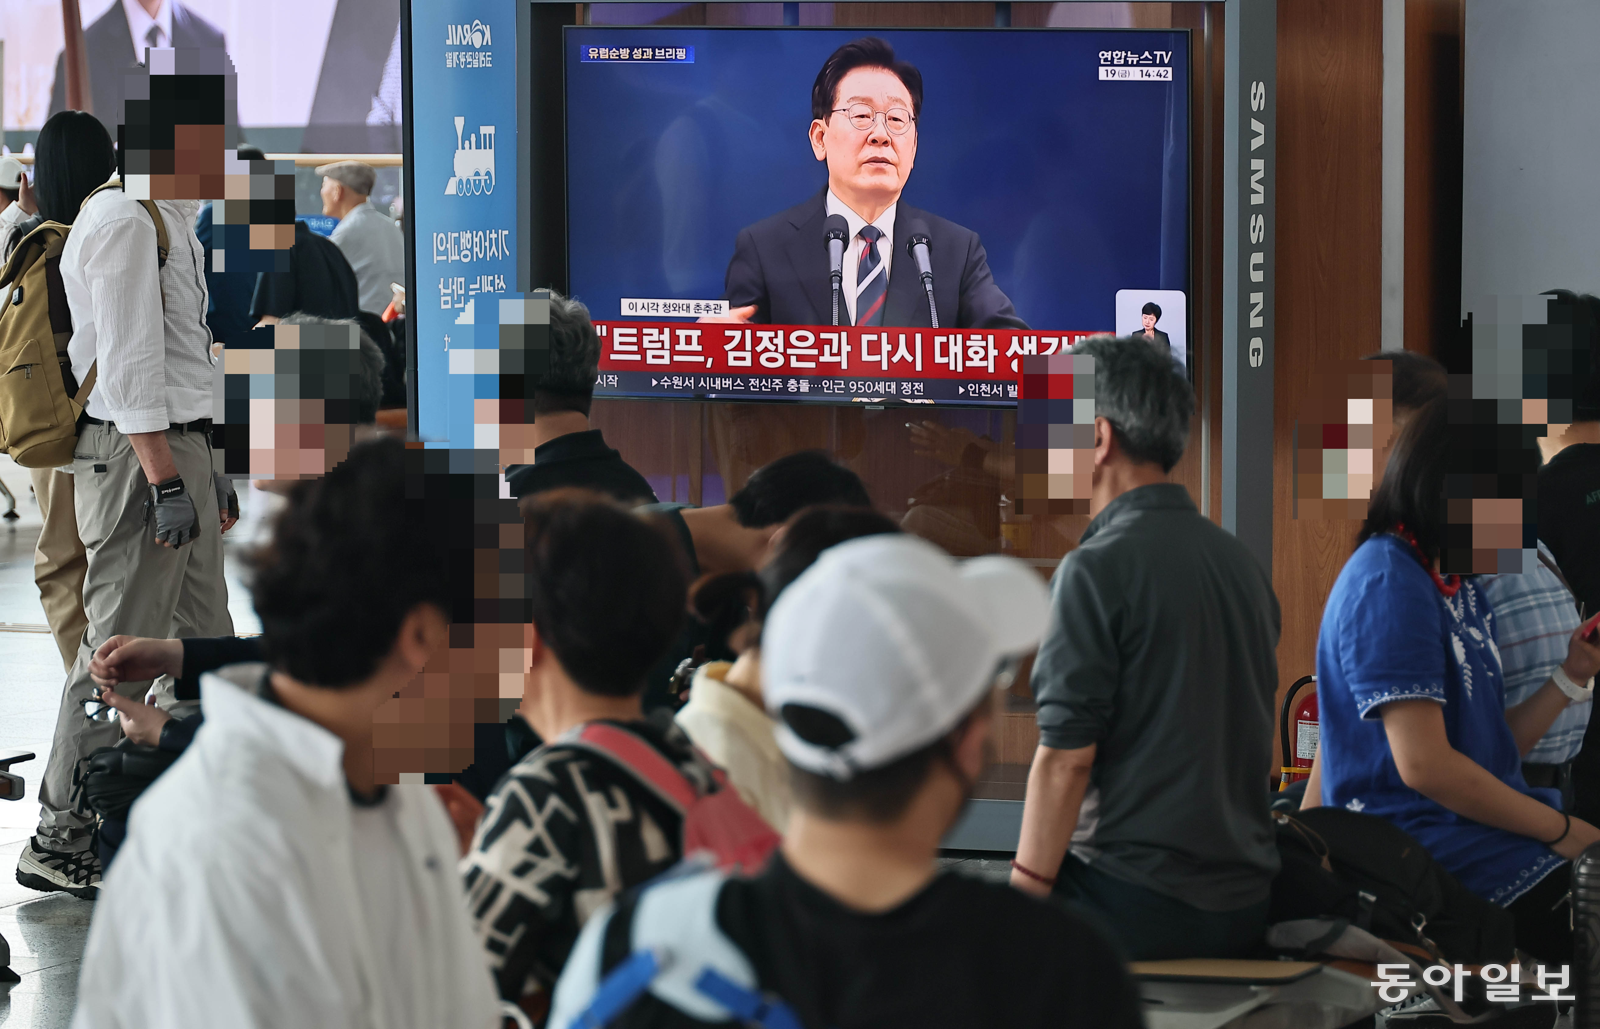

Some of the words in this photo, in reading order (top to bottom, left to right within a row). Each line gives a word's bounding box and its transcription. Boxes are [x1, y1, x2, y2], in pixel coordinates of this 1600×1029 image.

[588, 47, 630, 60] 유럽순방
[632, 48, 653, 60] 성과
[654, 48, 687, 60] 브리핑
[1098, 50, 1172, 65] 연합뉴스TV
[1139, 69, 1169, 79] 14:42
[1249, 80, 1266, 368] SAMSUNG
[628, 302, 638, 313] 이
[640, 302, 659, 314] 시각
[662, 302, 691, 314] 청와대
[693, 303, 723, 315] 춘추관
[723, 329, 852, 370] 김정은과
[861, 332, 923, 372] 다시
[934, 333, 999, 374] 대화
[659, 375, 695, 390] 수원서
[698, 376, 745, 391] 시내버스
[748, 378, 783, 392] 전신주
[848, 380, 897, 395] 950세대
[900, 381, 925, 396] 정전
[967, 382, 1003, 398] 인천서
